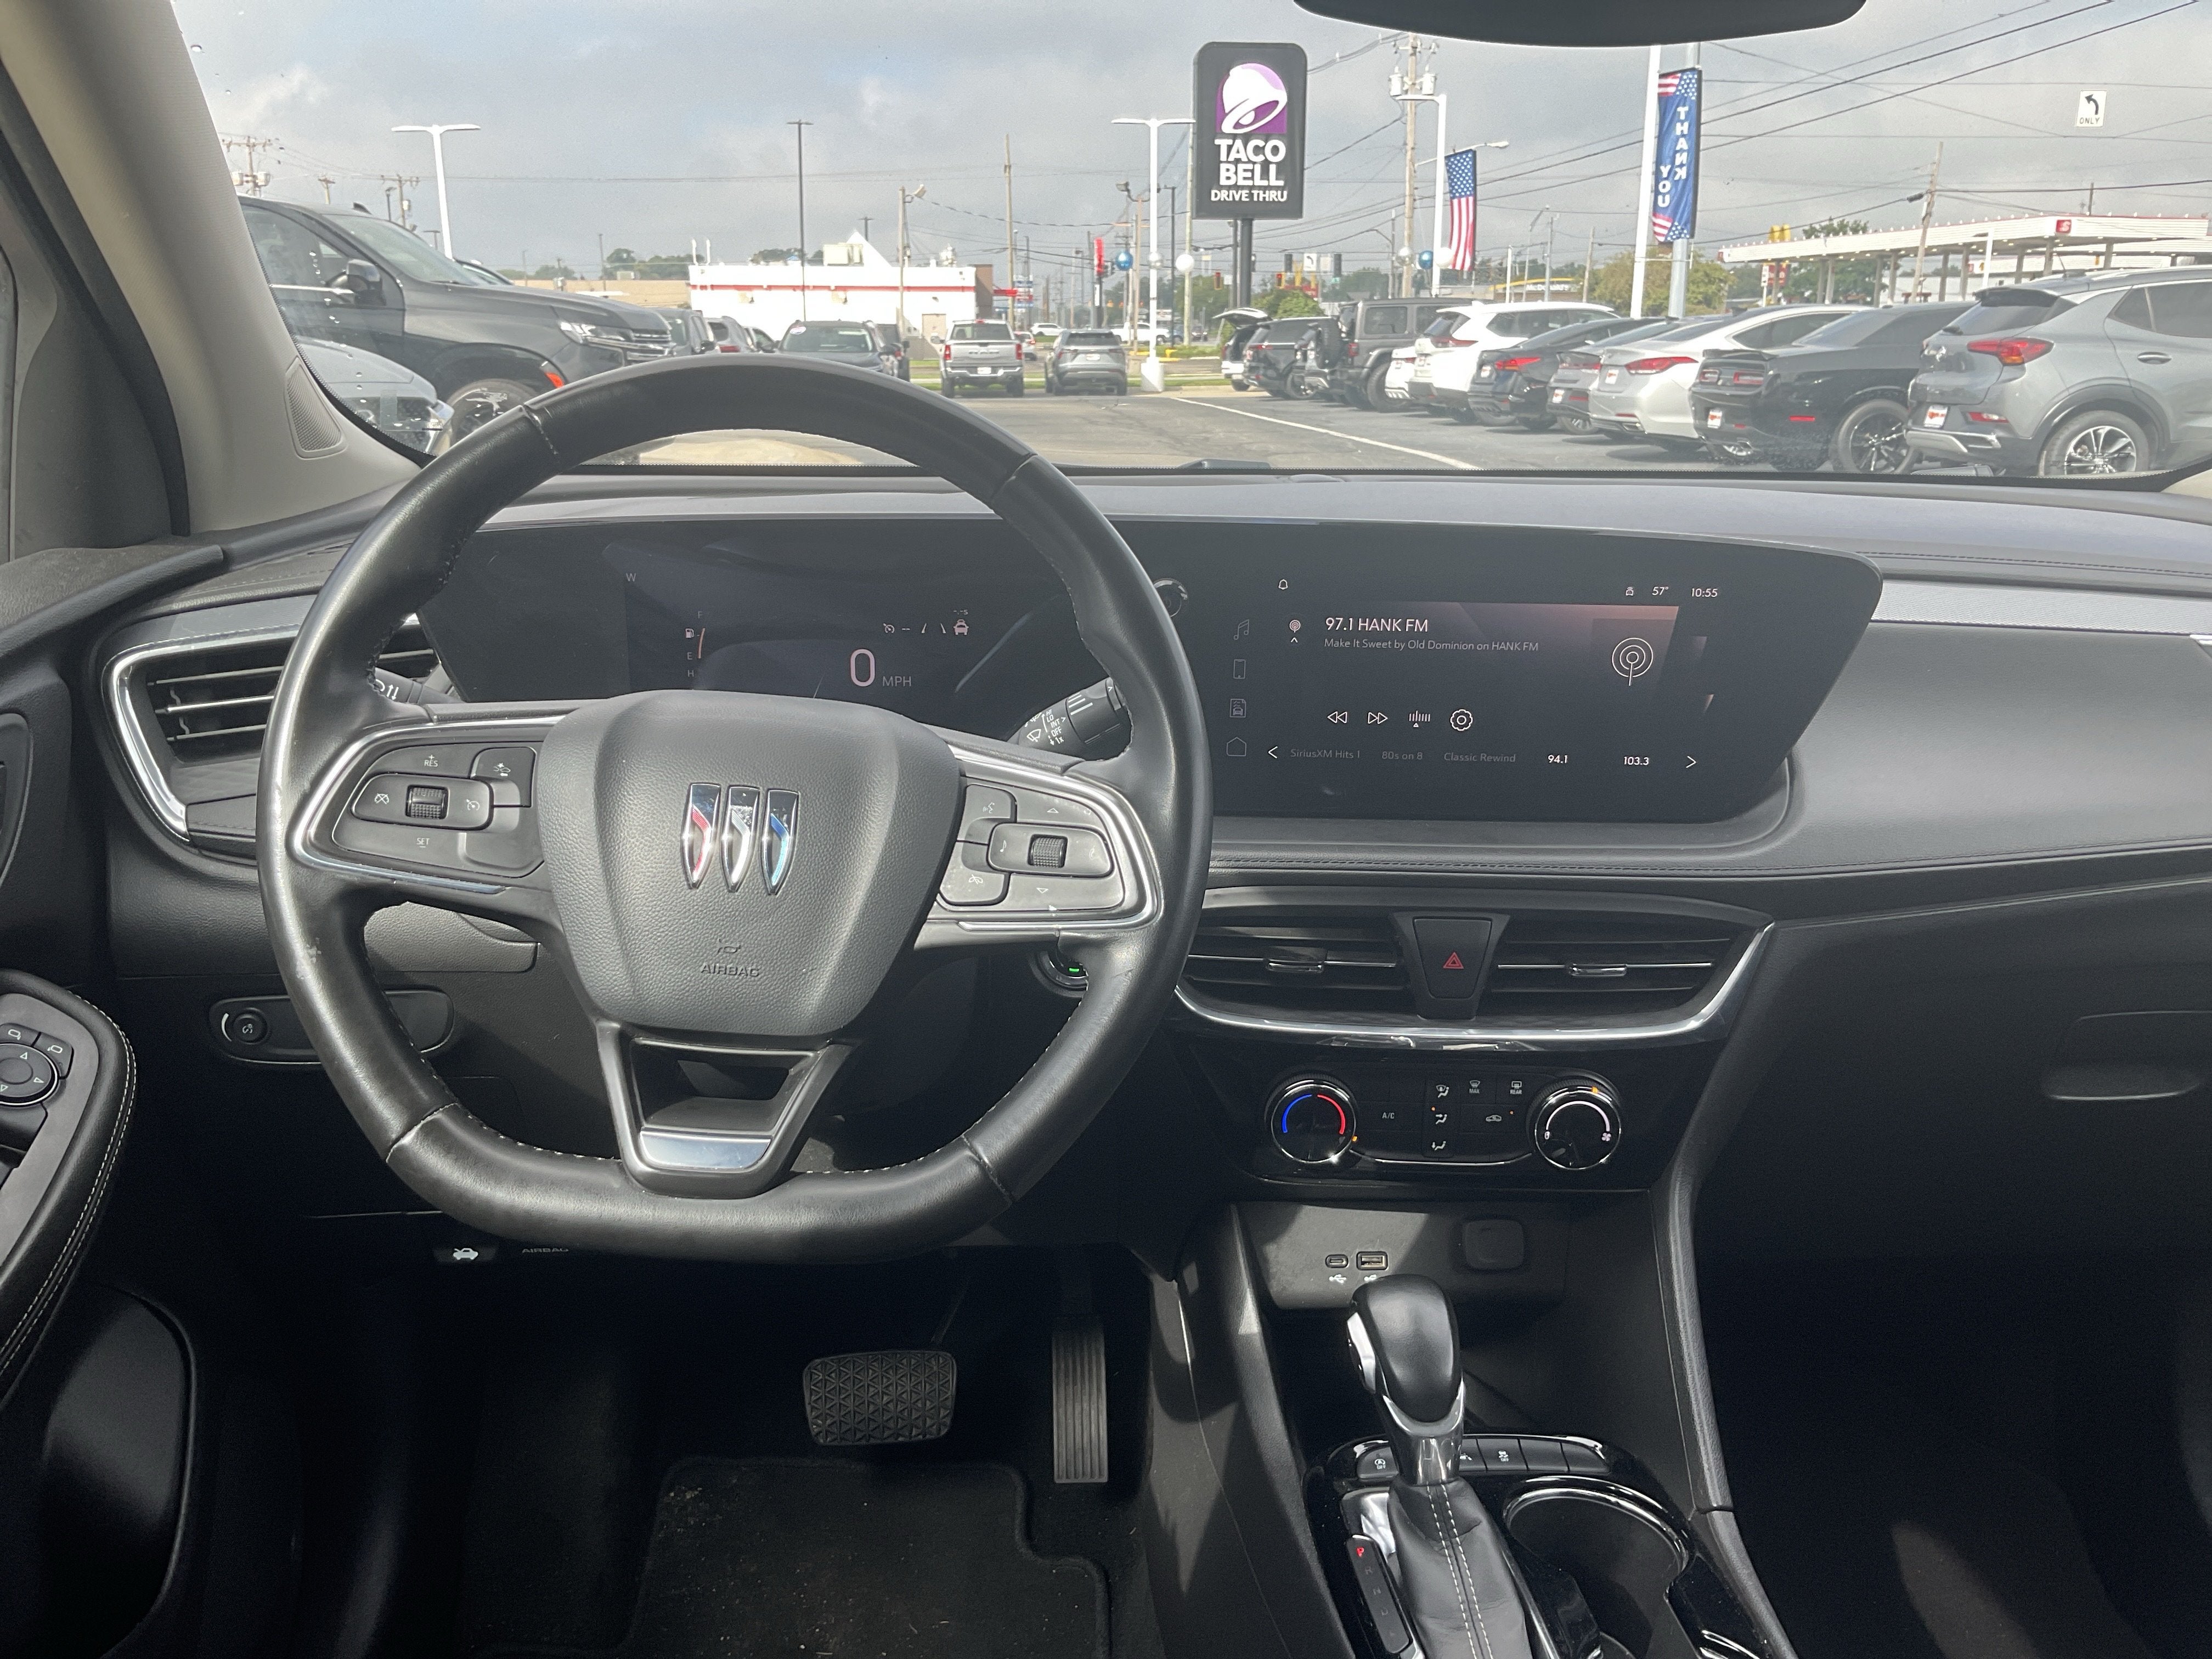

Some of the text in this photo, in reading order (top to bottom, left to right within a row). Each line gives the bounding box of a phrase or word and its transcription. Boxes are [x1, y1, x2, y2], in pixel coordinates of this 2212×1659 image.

[1214, 139, 1286, 162] TACO
[1220, 163, 1284, 186] BELL
[1211, 190, 1287, 201] DRIVE THRU
[1652, 586, 1669, 596] 57°
[1691, 588, 1718, 597] 10:55
[697, 611, 703, 619] F
[1325, 617, 1428, 632] 97.1 HANK FM
[1324, 639, 1351, 648] Make
[1353, 639, 1359, 648] It
[1362, 639, 1391, 649] Sweet
[1393, 640, 1406, 651] by
[1407, 640, 1425, 650] Old
[1428, 640, 1474, 651] Dominion
[1492, 642, 1521, 651] HANK
[1523, 642, 1538, 651] FM
[687, 652, 693, 660] E
[850, 648, 912, 687] 0 MPH
[687, 669, 695, 678] H
[1051, 727, 1062, 737] OFF
[1290, 748, 1332, 759] SiriusXM
[1335, 749, 1354, 759] Hits
[1381, 751, 1400, 760] 80s
[1417, 752, 1423, 760] 8
[1444, 752, 1516, 763] Classic Rewind
[1548, 754, 1568, 764] 94.1
[1623, 757, 1649, 766] 103.3
[701, 962, 760, 977] AIRBAG
